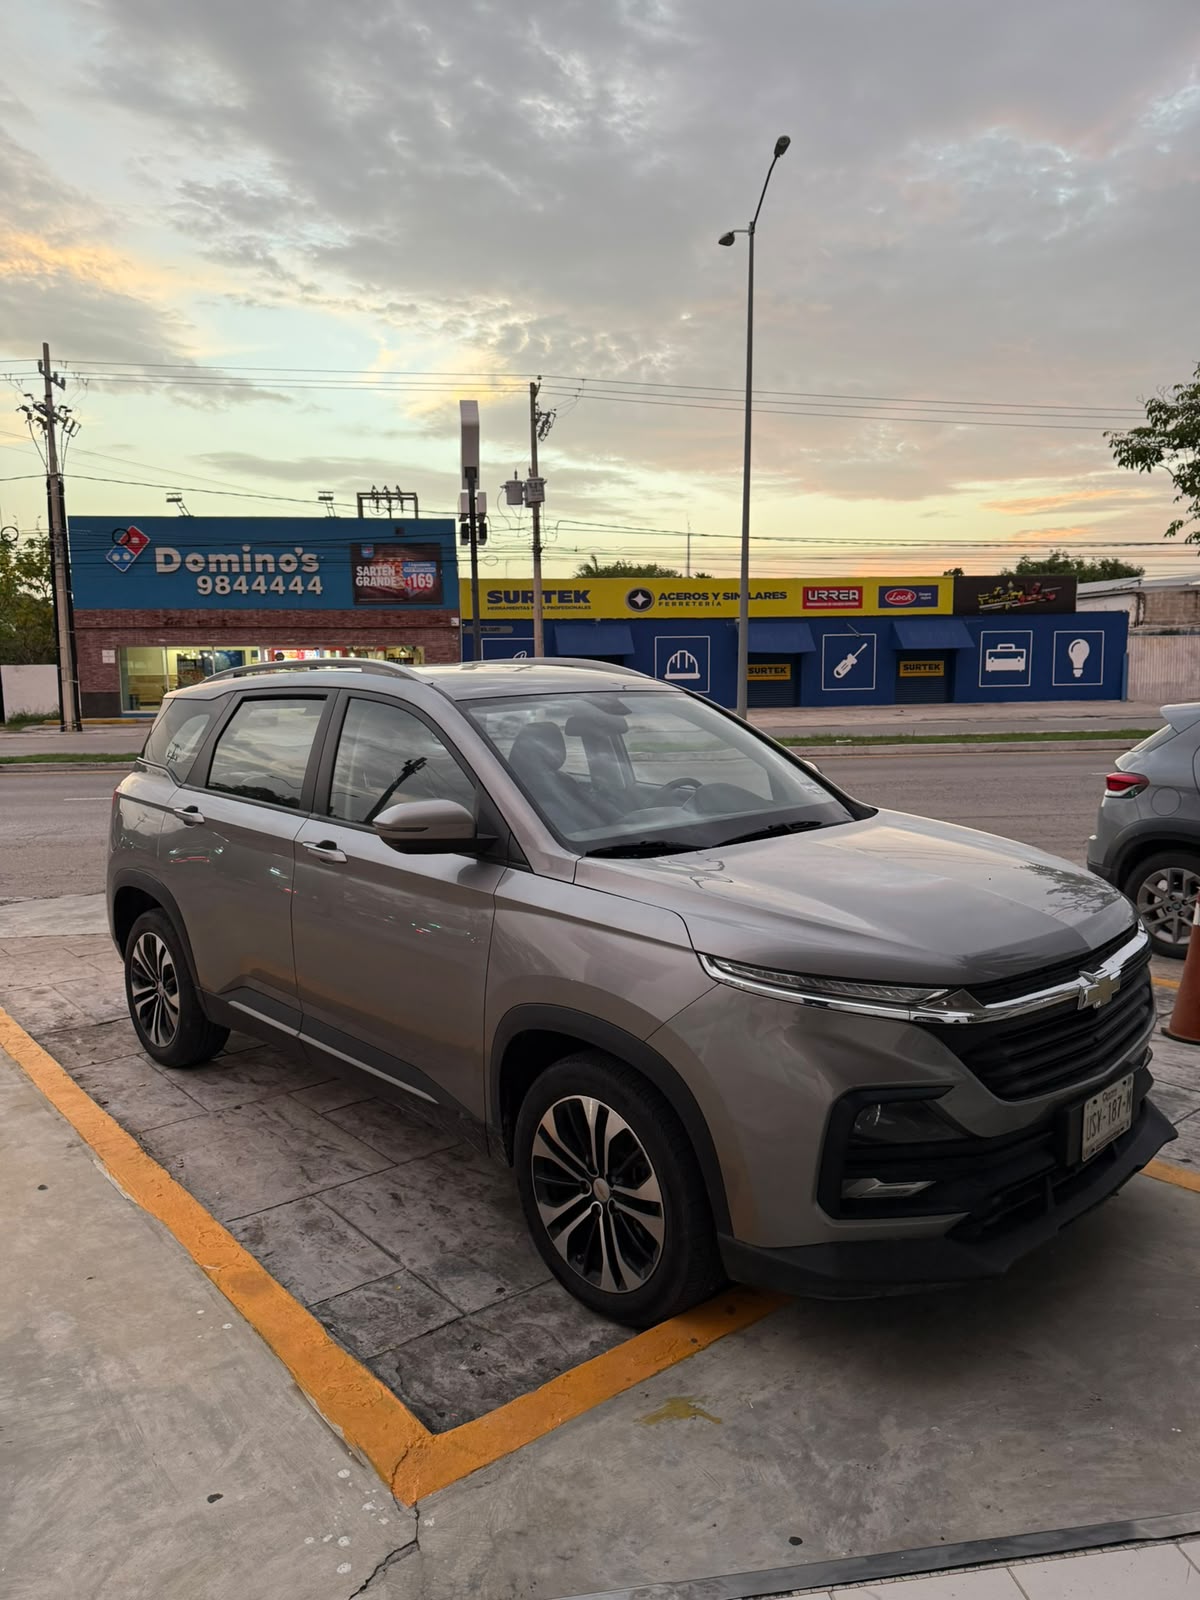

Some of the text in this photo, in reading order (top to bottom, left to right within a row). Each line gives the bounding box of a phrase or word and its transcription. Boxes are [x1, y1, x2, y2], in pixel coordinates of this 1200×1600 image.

[154, 544, 319, 573] Domino's
[196, 575, 323, 595] 9844444
[355, 576, 396, 587] GRANDE
[487, 590, 591, 604] SURTEK
[658, 591, 787, 600] ACEROS Y SIMLARES
[808, 589, 859, 601] URREA
[889, 591, 913, 601] Lock
[748, 666, 786, 674] SURTEK
[903, 663, 941, 671] SURTEK
